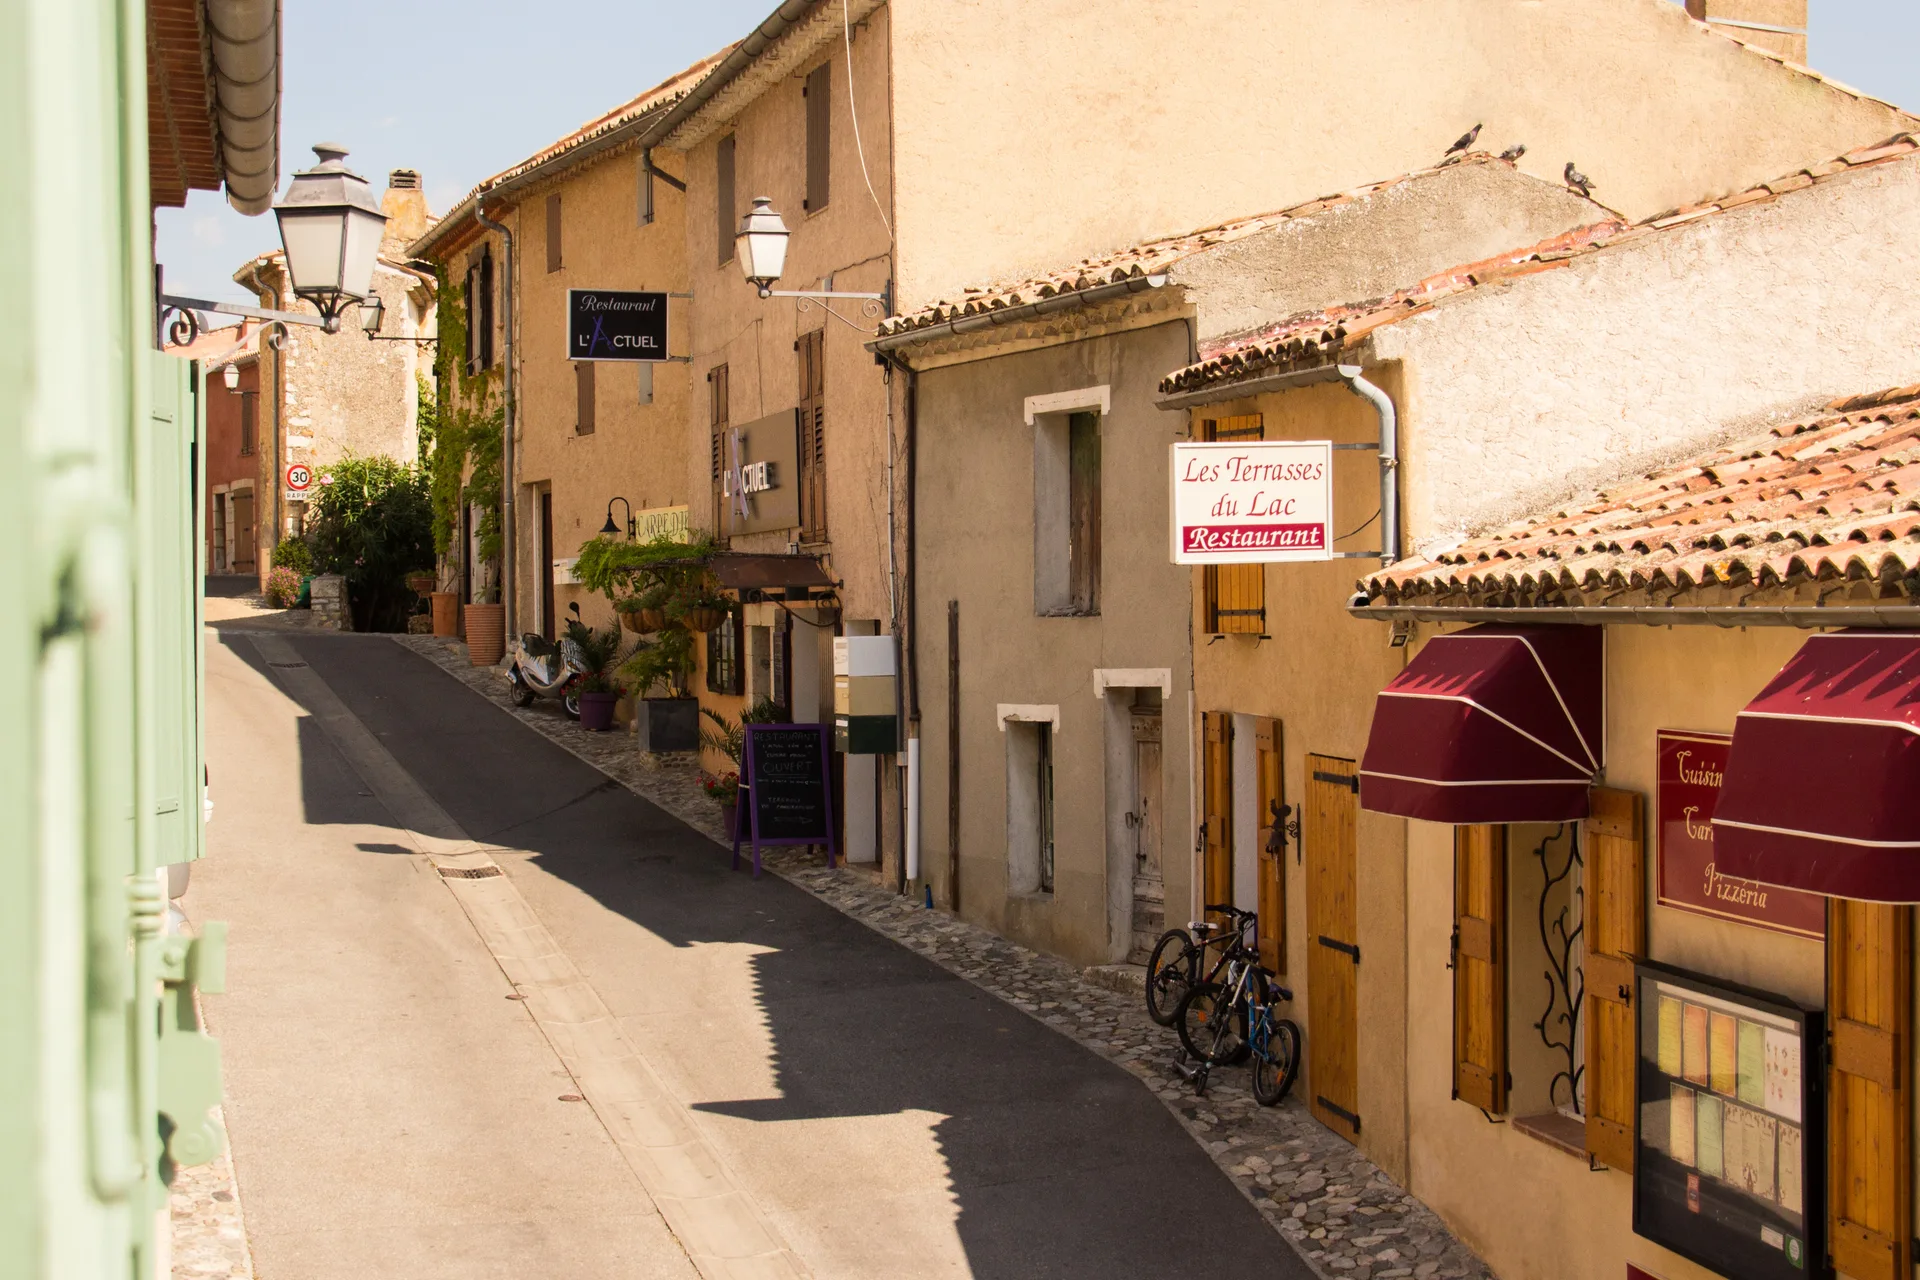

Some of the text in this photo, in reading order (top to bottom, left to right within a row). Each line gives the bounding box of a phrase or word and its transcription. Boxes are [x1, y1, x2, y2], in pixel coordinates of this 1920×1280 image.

[580, 294, 657, 312] Restaurant
[292, 471, 308, 483] 30
[1182, 455, 1323, 483] Les Terrasses
[1211, 491, 1297, 517] du Lac
[637, 513, 669, 538] CARPE
[1189, 526, 1321, 551] Restaurant
[754, 731, 819, 742] RESTAURANT
[762, 759, 813, 773] OUVERT
[1676, 750, 1724, 788] Cuisin
